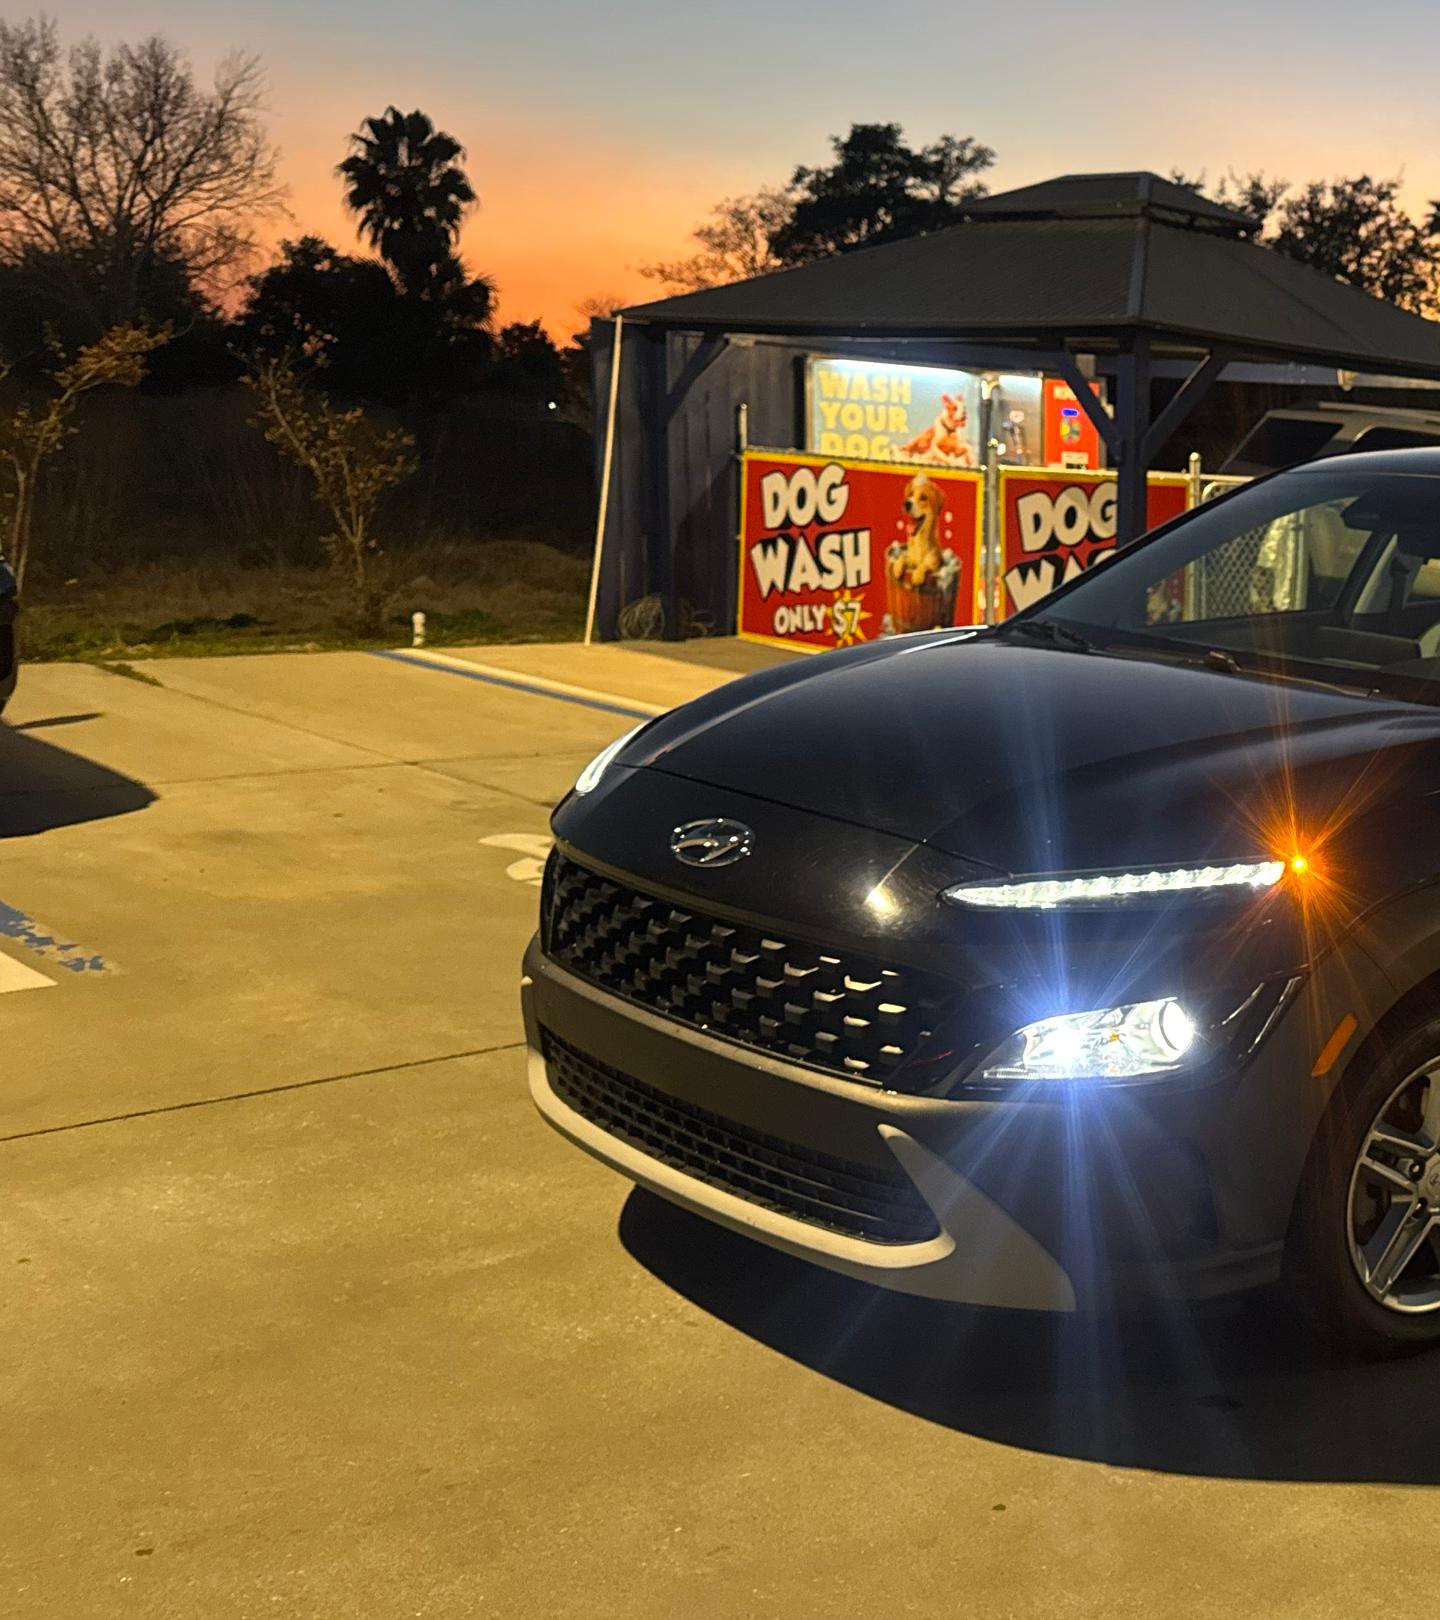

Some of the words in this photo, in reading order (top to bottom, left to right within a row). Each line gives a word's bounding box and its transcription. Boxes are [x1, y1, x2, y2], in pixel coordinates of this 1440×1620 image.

[818, 369, 912, 405] WASH
[818, 401, 909, 433] YOUR
[820, 431, 891, 460] DOG
[762, 464, 849, 530] DOG
[1017, 482, 1118, 552] DOG
[751, 529, 871, 600] WASH
[774, 603, 826, 635] ONLY
[831, 601, 862, 638] $7
